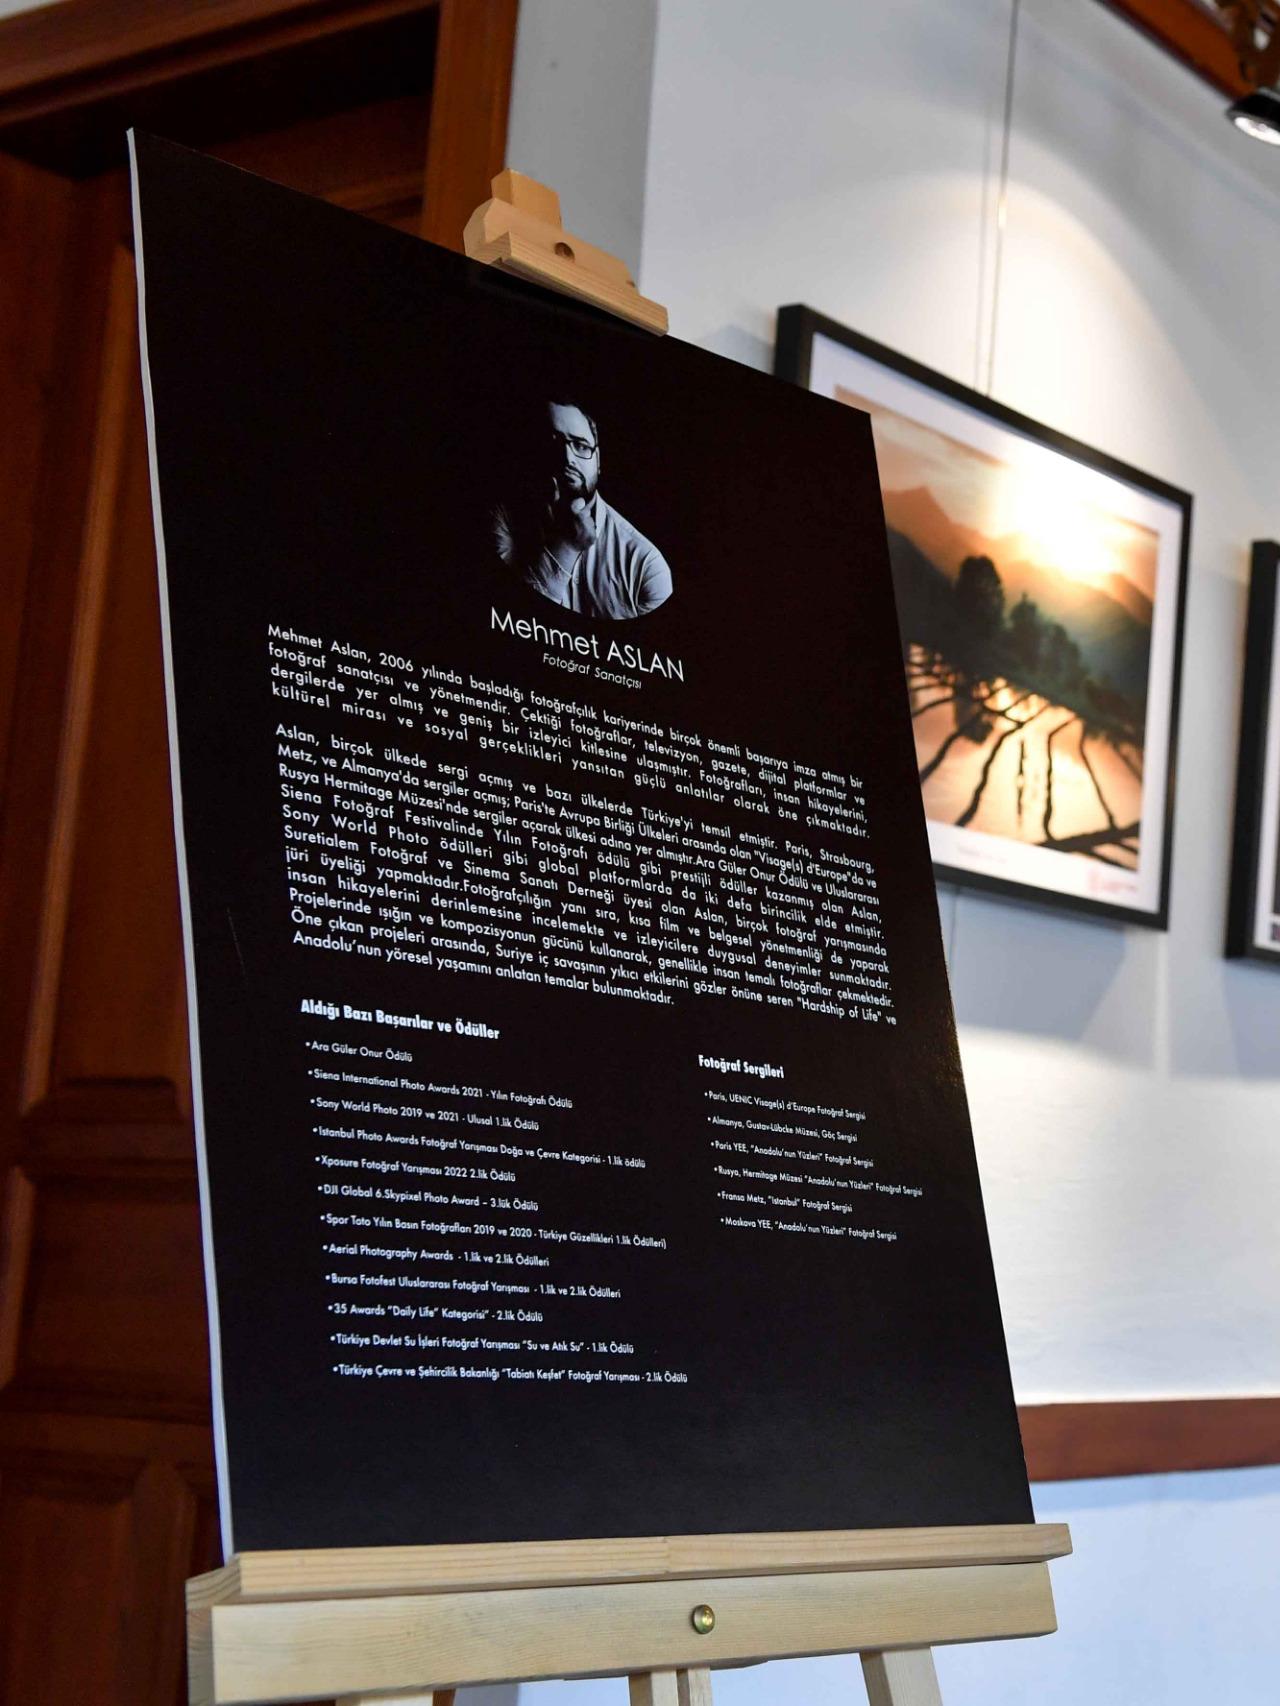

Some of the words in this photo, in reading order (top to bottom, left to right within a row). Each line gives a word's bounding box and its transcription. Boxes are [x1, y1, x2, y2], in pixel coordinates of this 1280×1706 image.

[267, 623, 322, 648] Mehmet
[330, 640, 370, 663] Aslan,
[378, 652, 413, 671] 2006
[421, 664, 462, 684] yılında
[469, 674, 523, 703] başladığı
[530, 690, 597, 719] fotoğrafçılık
[602, 709, 663, 736] kariyerinde
[669, 727, 701, 747] birçok
[707, 738, 740, 756] önemli
[745, 747, 788, 770] başarıya
[792, 760, 816, 776] imza
[821, 770, 845, 786] atmış
[849, 774, 862, 788] bir
[491, 606, 599, 658] Mehmet
[606, 640, 683, 681] ASLAN
[542, 652, 590, 674] Fotoğraf
[594, 666, 641, 688] Sanatçısı
[268, 641, 326, 668] fotoğraf
[336, 663, 393, 685] sanatçısı
[404, 680, 419, 691] ve
[429, 686, 510, 715] yönetmendir.
[520, 706, 561, 730] Çektiği
[570, 718, 635, 748] fotoğraflar,
[644, 739, 702, 765] televizyon,
[711, 759, 749, 777] gazete,
[758, 767, 786, 785] dijital
[793, 777, 847, 800] platformlar
[853, 795, 865, 805] ve
[270, 662, 344, 692] dergilerde
[355, 687, 378, 700] yer
[389, 692, 423, 714] almış
[433, 706, 448, 717] ve
[459, 713, 492, 731] geniş
[501, 718, 519, 734] bir
[528, 726, 571, 747] izleyici
[580, 738, 627, 761] kitlesine
[636, 754, 690, 777] ulaşmıştır.
[699, 769, 765, 798] Fotoğrafları,
[773, 787, 800, 804] insan
[807, 795, 867, 823] hikayelerini,
[271, 680, 329, 707] kültürel
[341, 702, 385, 721] mirası
[397, 716, 413, 727] ve
[424, 723, 468, 740] sosyal
[478, 736, 561, 763] gerçeklikleri
[571, 758, 624, 778] yansıtan
[634, 772, 666, 788] güçlü
[675, 782, 724, 802] anlatılar
[733, 795, 769, 813] olarak
[777, 806, 797, 820] öne
[805, 813, 869, 838] çıkmaktadır.
[284, 824, 358, 851] Suretialem
[370, 841, 427, 864] Fotoğraf
[437, 858, 452, 869] ve
[463, 859, 509, 880] Sinema
[519, 871, 558, 890] Sanatı
[567, 880, 614, 904] Derneği
[623, 893, 652, 909] üyesi
[661, 900, 685, 915] olan
[694, 907, 727, 926] Aslan,
[735, 913, 768, 932] birçok
[775, 921, 816, 942] fotoğraf
[823, 936, 886, 956] yarışmasında
[285, 845, 308, 862] jüri
[320, 852, 365, 876] üyeliği
[560, 901, 586, 914] yanı
[595, 908, 619, 923] sıra,
[628, 910, 650, 927] kısa
[659, 916, 679, 932] film
[687, 926, 700, 936] ve
[708, 925, 752, 946] belgesel
[759, 939, 822, 963] yönetmenliği
[830, 950, 842, 964] de
[849, 958, 889, 973] yaparak
[287, 866, 326, 885] insan
[337, 873, 419, 902] hikayelerini
[430, 892, 521, 921] derinlemesine
[531, 911, 604, 936] incelemekte
[613, 930, 627, 940] ve
[636, 931, 698, 954] izleyicilere
[707, 943, 756, 964] duygusal
[764, 954, 821, 976] deneyimler
[829, 971, 891, 990] sunmaktadır.
[289, 886, 371, 914] Projelerinde
[378, 905, 411, 923] ışığın
[418, 914, 433, 925] ve
[440, 912, 535, 943] kompozisyonun
[541, 934, 583, 951] gücünü
[589, 939, 651, 965] kullanarak,
[657, 956, 707, 974] genellikle
[712, 963, 740, 979] insan
[744, 970, 775, 986] temalı
[779, 974, 831, 996] fotoğraflar
[836, 987, 894, 1007] çekmektedir.
[300, 998, 340, 1020] Aldığı
[343, 1004, 372, 1021] Bazı
[375, 1009, 433, 1029] Başarılar
[436, 1021, 451, 1032] ve
[454, 1017, 499, 1039] Ödüller
[385, 947, 432, 964] yöresel
[436, 957, 491, 974] yaşamını
[495, 964, 541, 982] anlatan
[544, 972, 589, 990] temalar
[592, 978, 674, 1004] bulunmaktadır.
[698, 1054, 740, 1073] Fotoğraf
[742, 1061, 784, 1078] Sergileri
